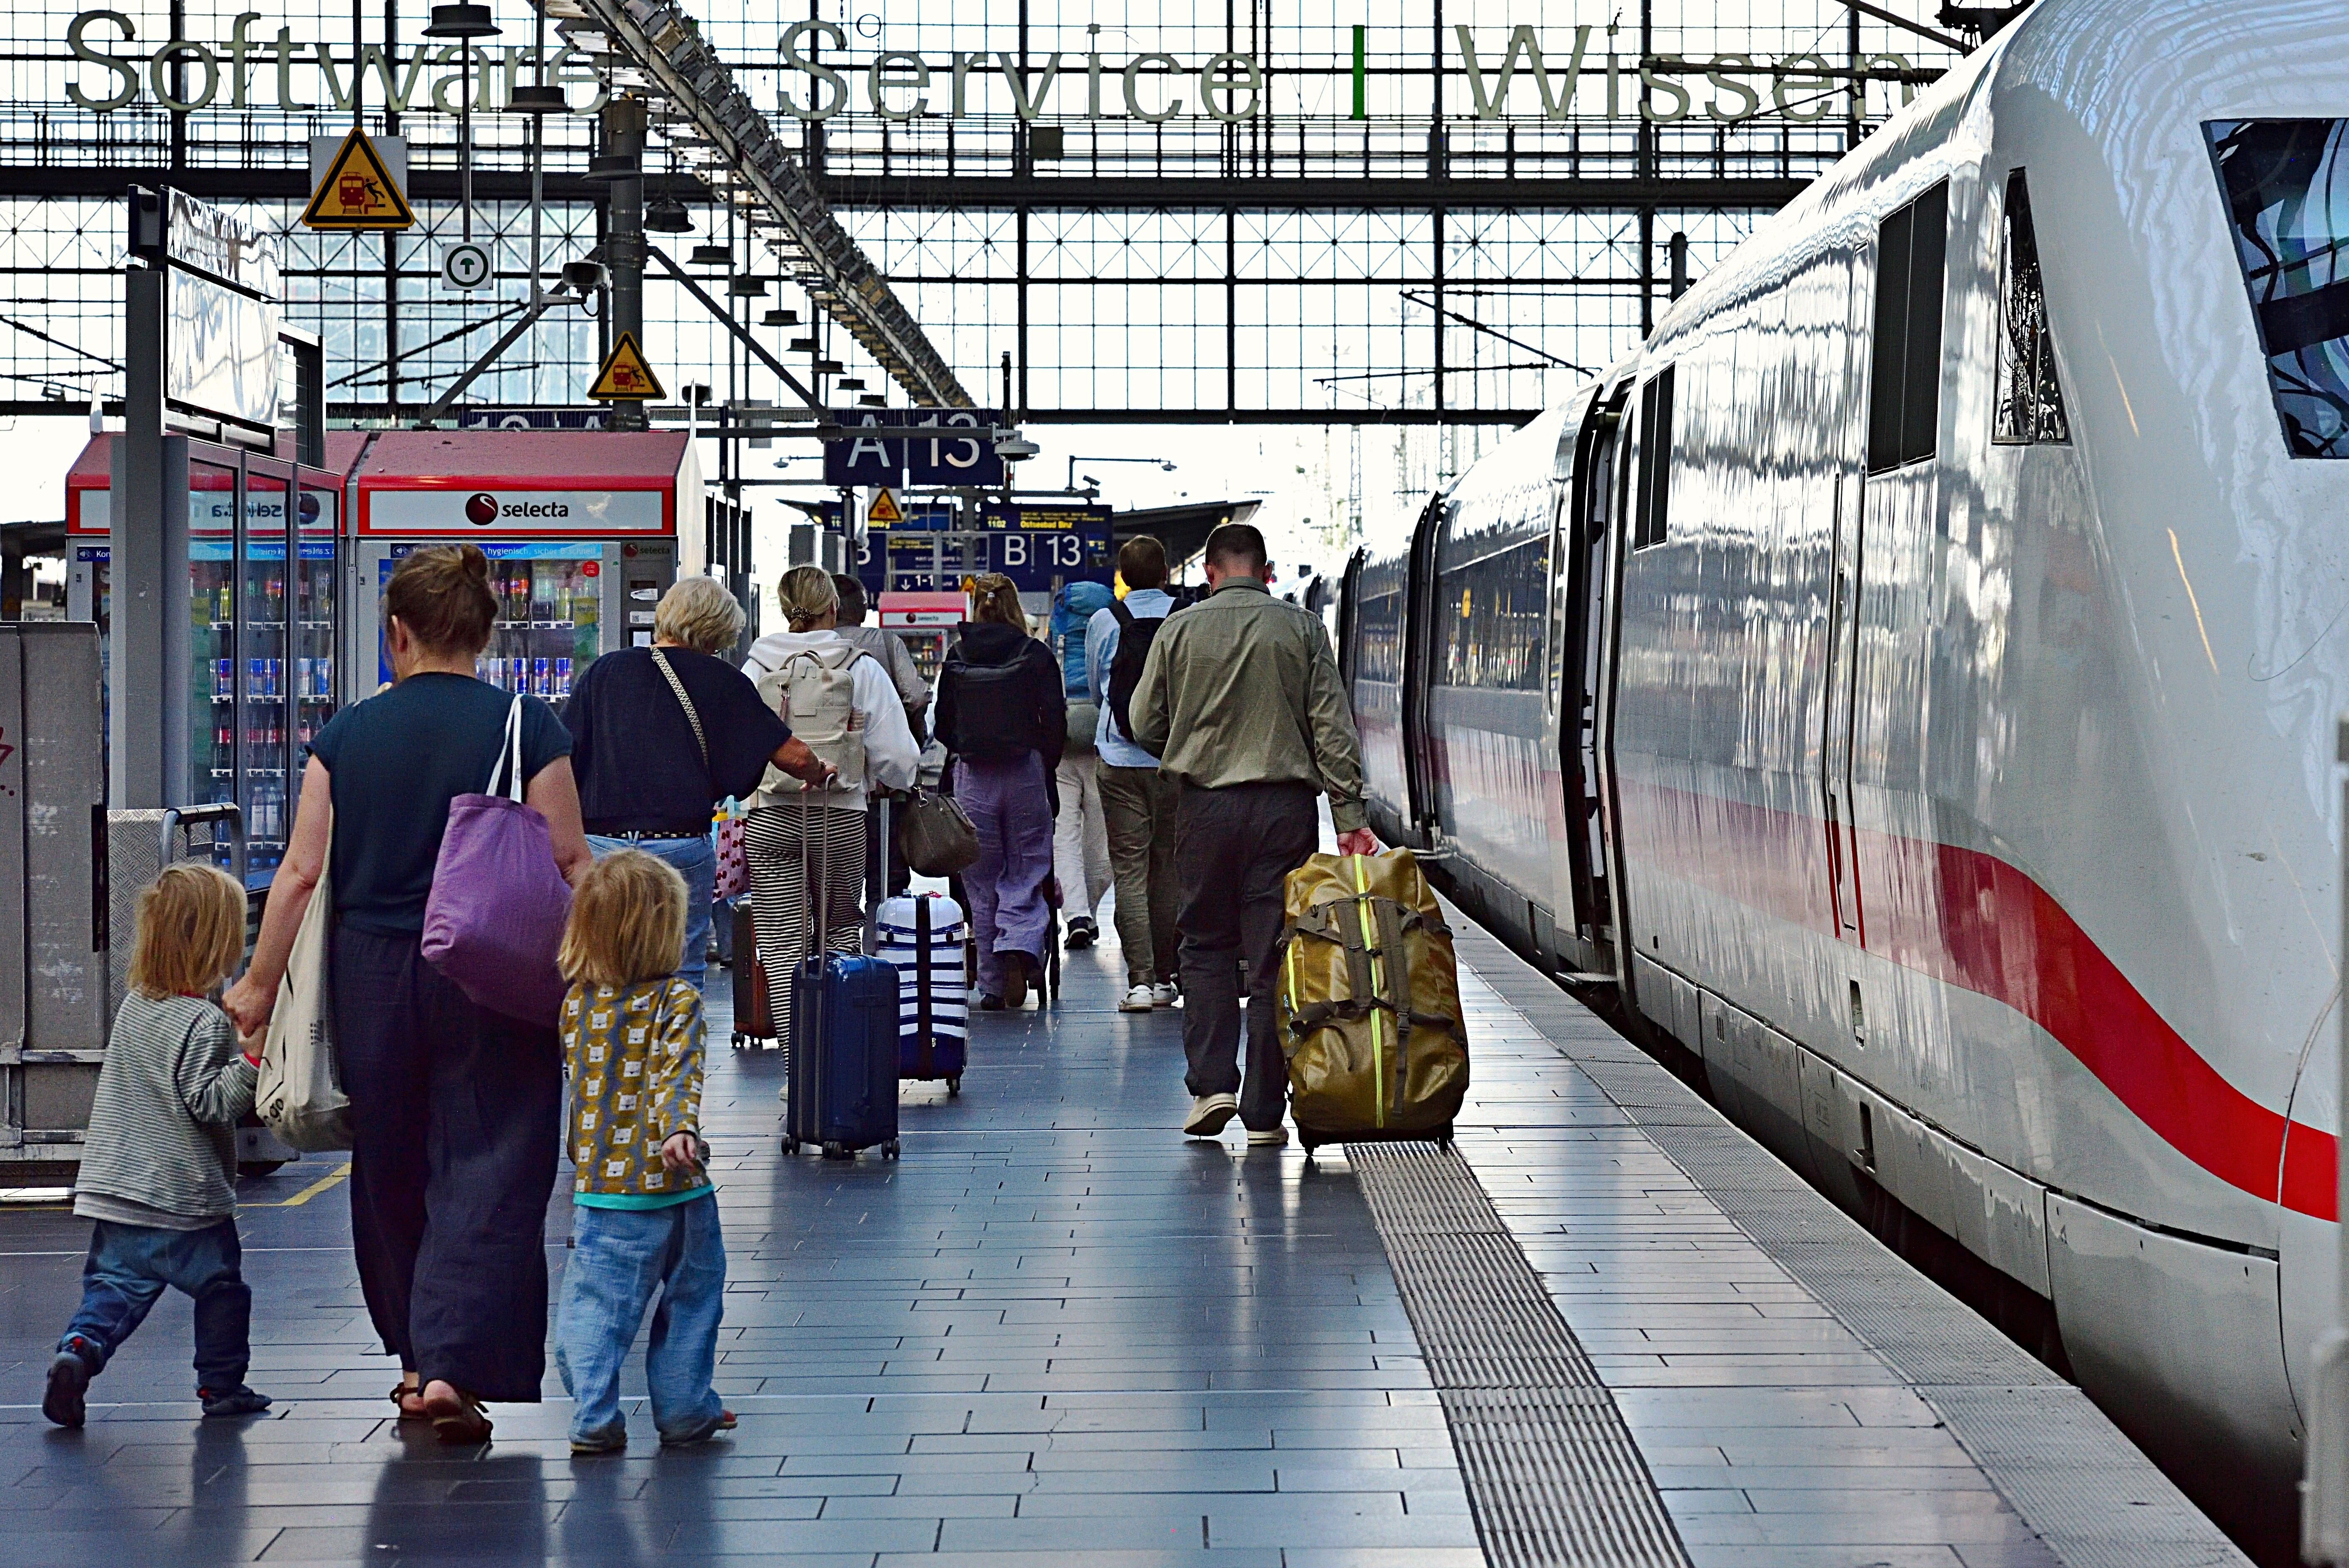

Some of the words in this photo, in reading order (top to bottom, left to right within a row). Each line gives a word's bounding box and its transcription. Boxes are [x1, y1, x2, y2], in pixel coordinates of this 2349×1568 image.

[64, 9, 610, 116] Software
[776, 19, 1262, 122] Service
[1454, 24, 1916, 122] Wissen
[847, 414, 890, 467] A
[918, 412, 980, 468] 13
[501, 501, 569, 517] selecta
[1005, 535, 1026, 566] B
[1046, 535, 1081, 566] 13
